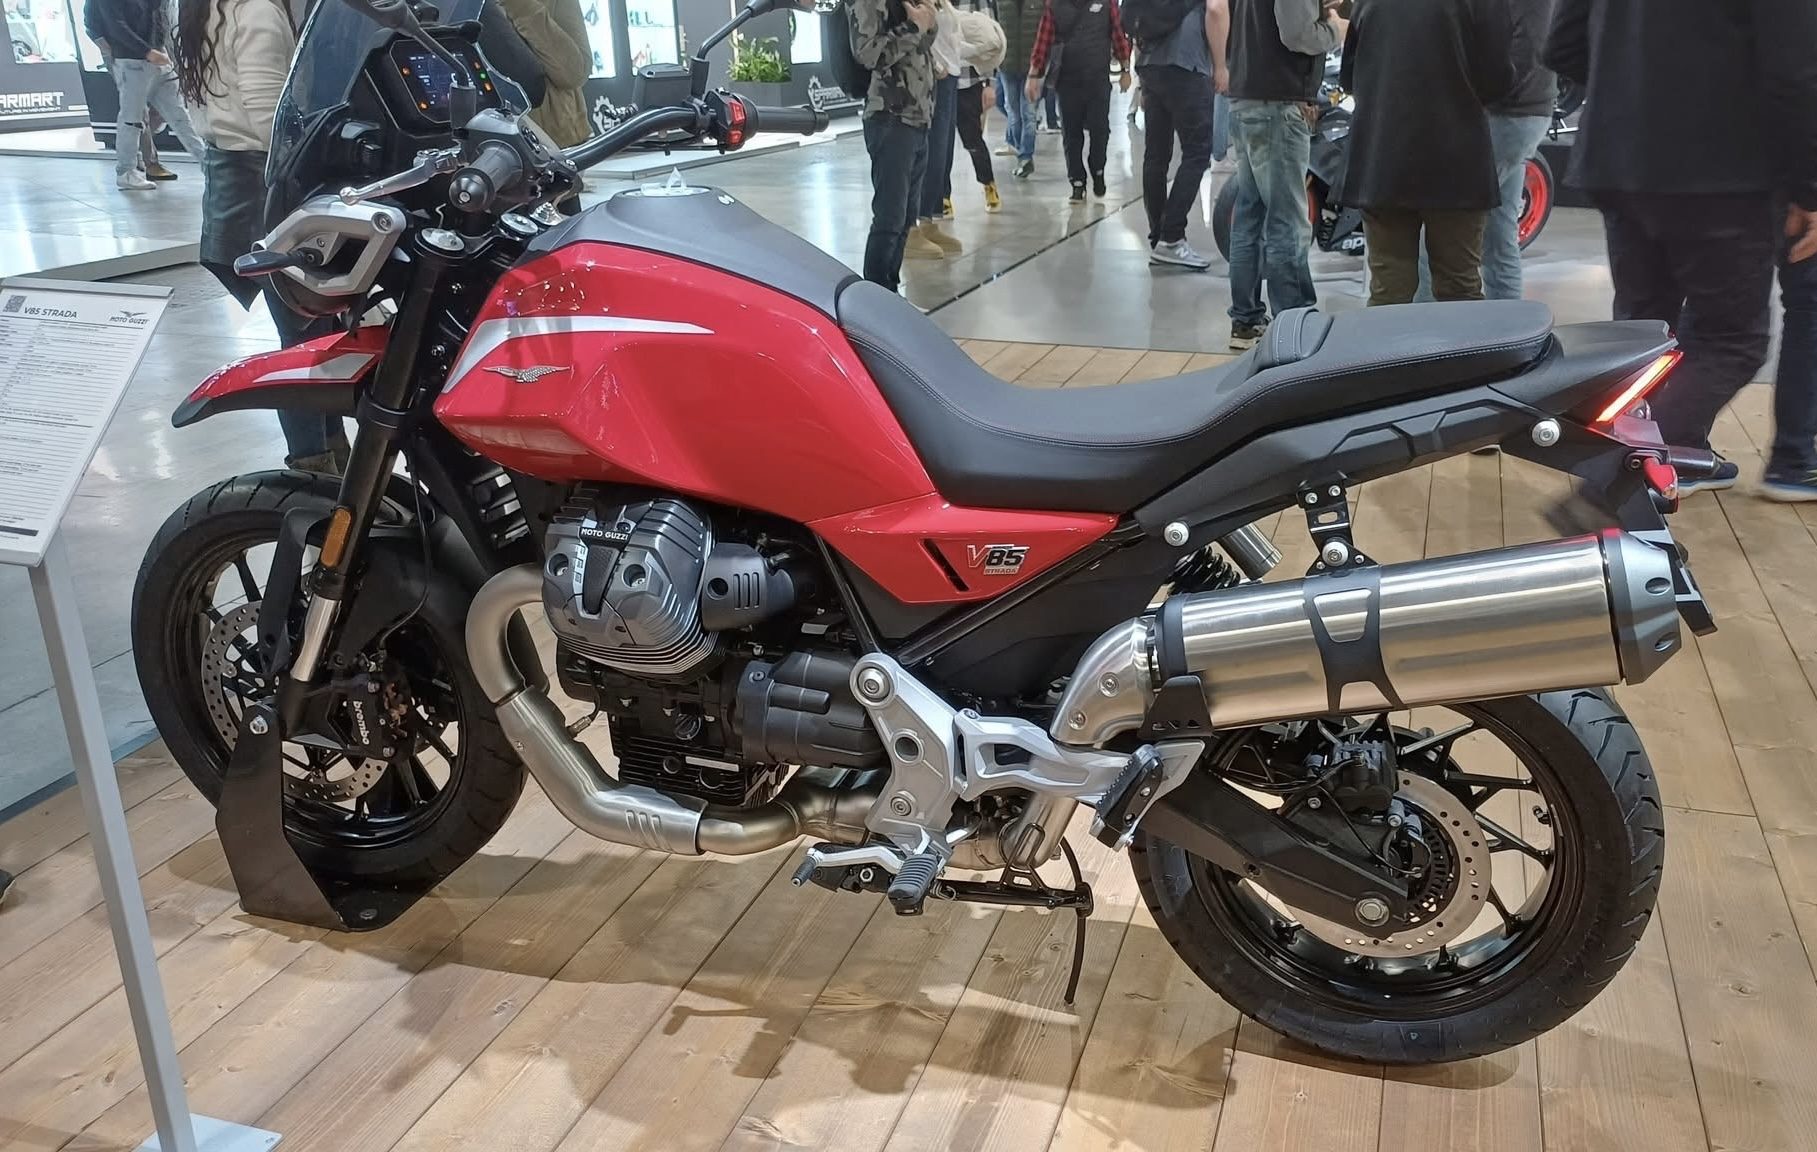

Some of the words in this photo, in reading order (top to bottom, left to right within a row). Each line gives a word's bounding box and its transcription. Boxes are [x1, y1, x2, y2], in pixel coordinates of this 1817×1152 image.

[24, 307, 40, 315] V85
[41, 308, 77, 318] STRADA
[581, 528, 603, 537] MOTO
[604, 531, 629, 540] GUZZI
[967, 543, 1030, 568] V85
[984, 567, 1018, 575] STRADA
[352, 700, 370, 745] brembo
